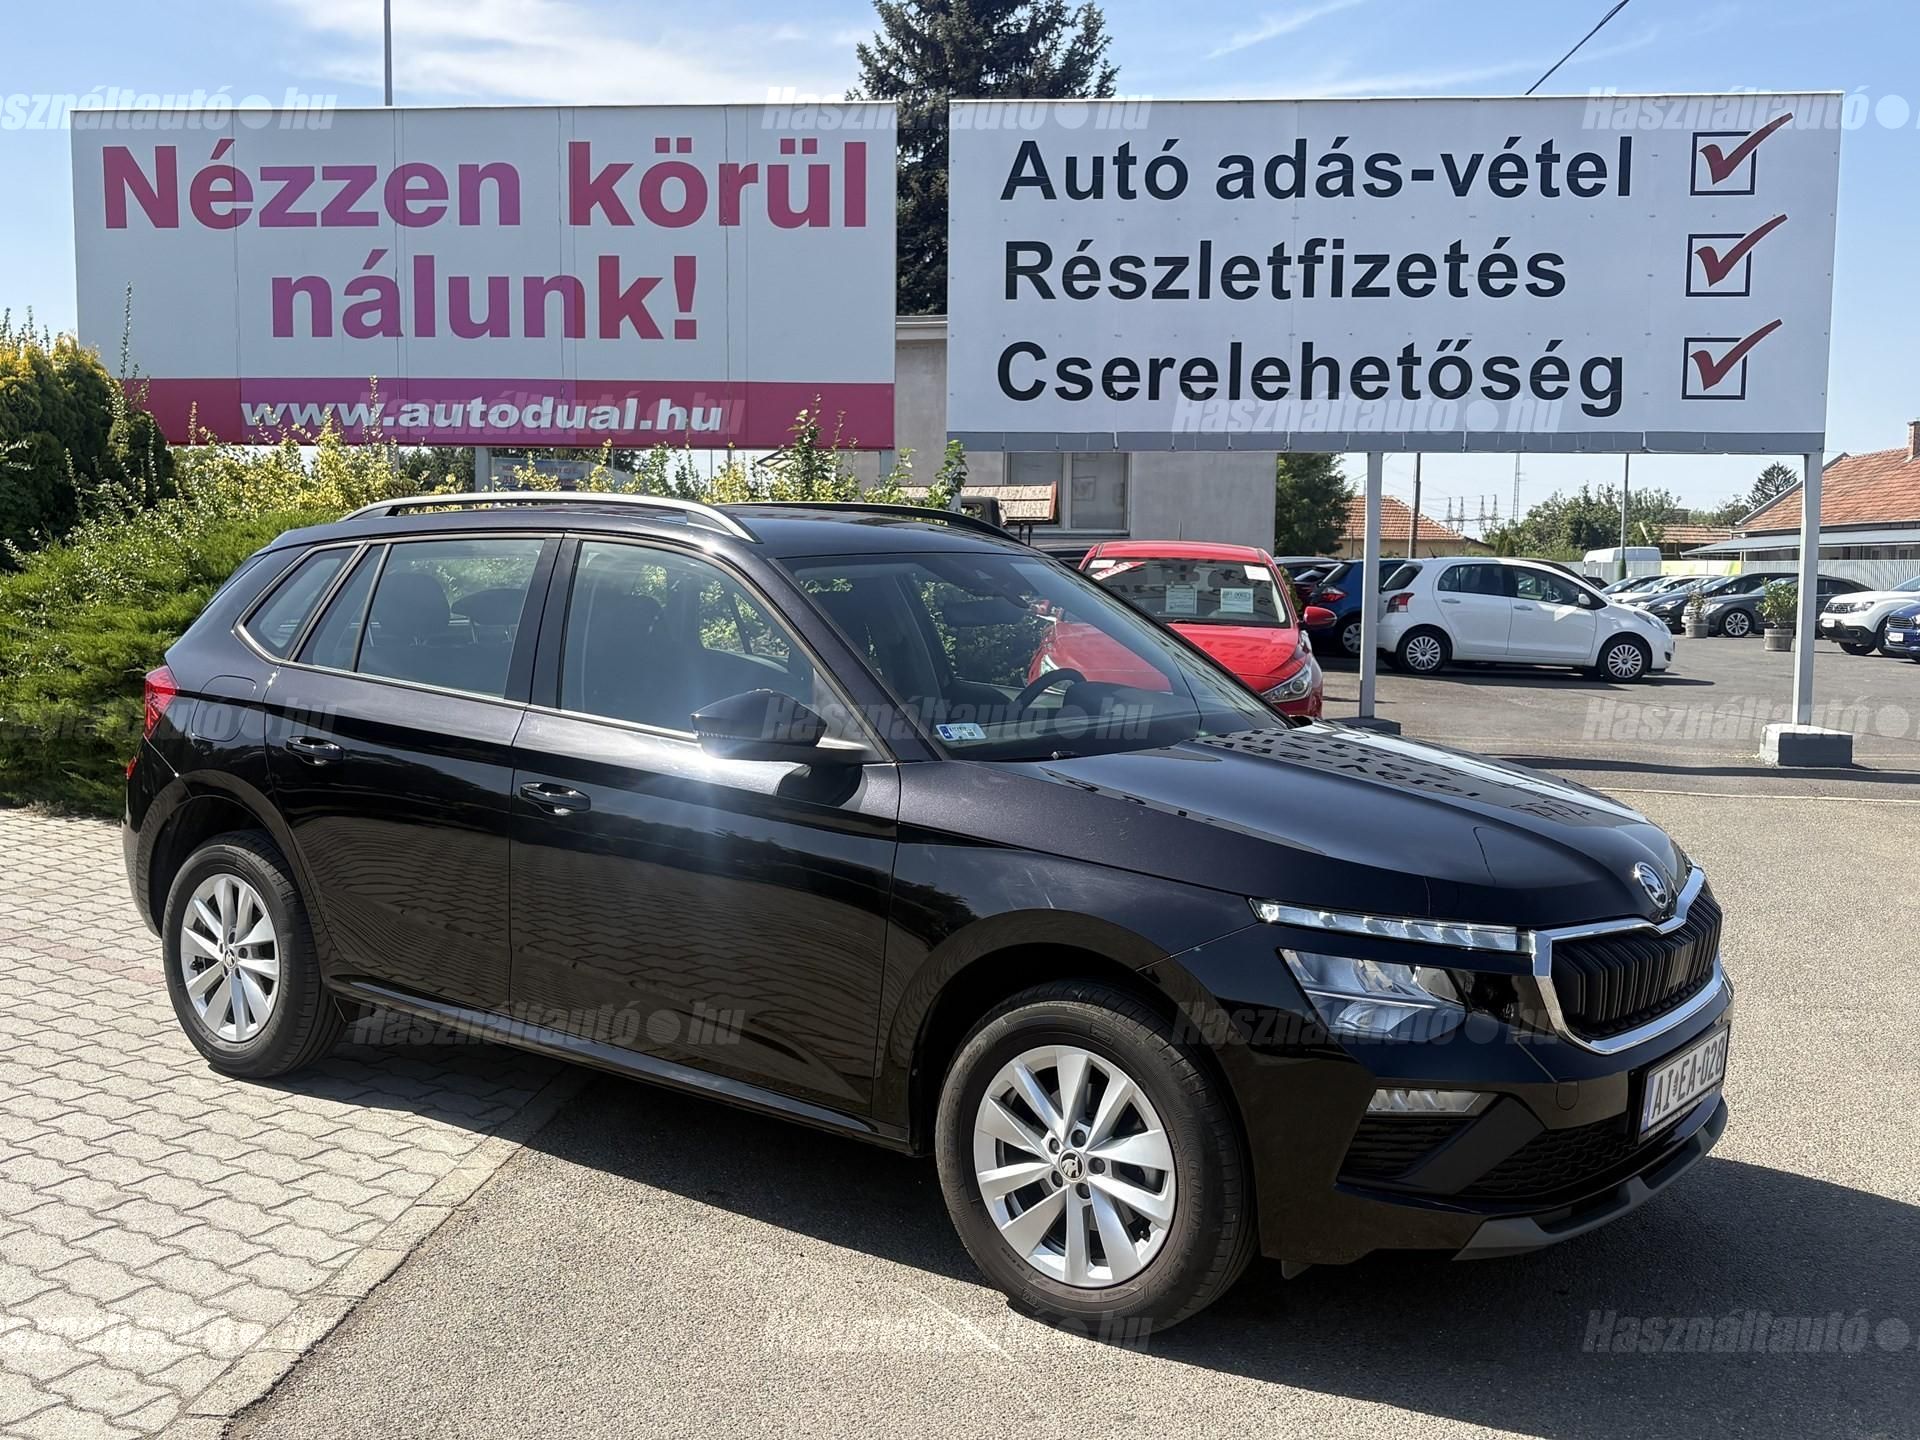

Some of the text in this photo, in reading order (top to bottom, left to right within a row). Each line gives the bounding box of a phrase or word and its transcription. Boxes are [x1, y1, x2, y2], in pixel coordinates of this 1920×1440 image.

[102, 137, 867, 230] Nézzen körül
[1001, 135, 1632, 201] Autó adás-vétel
[272, 249, 698, 340] nálunk!
[1005, 236, 1567, 301] Részletfizetés
[997, 339, 1624, 418] Cserelehetőség
[240, 396, 723, 431] www.autodual.hu
[1652, 1069, 1675, 1120] AI
